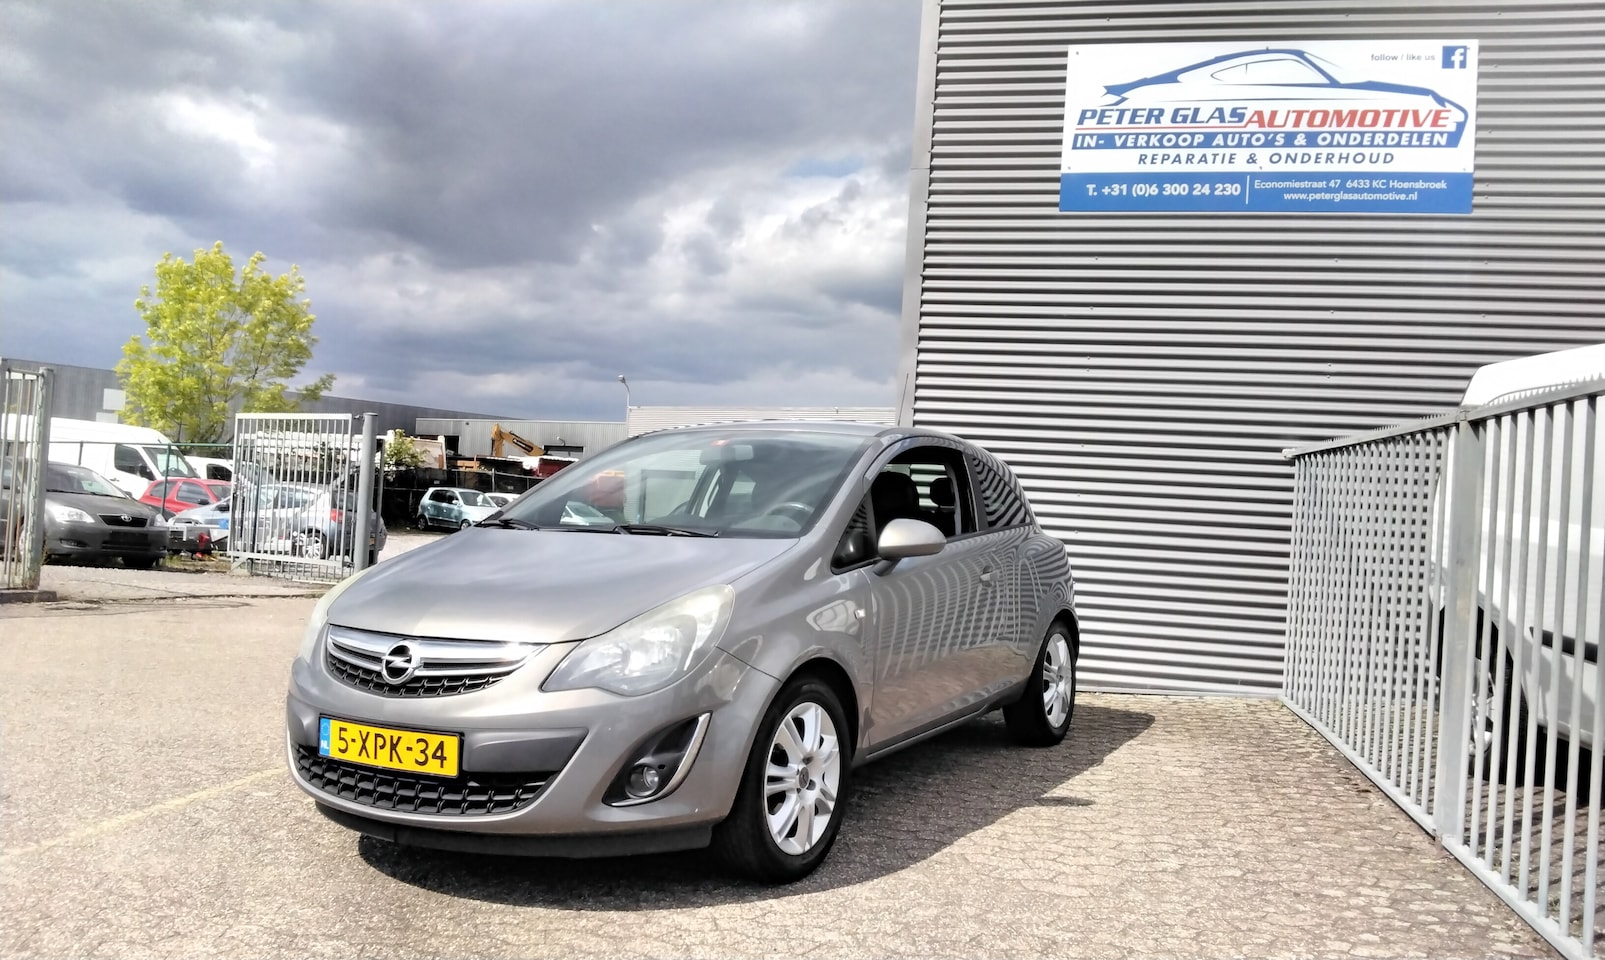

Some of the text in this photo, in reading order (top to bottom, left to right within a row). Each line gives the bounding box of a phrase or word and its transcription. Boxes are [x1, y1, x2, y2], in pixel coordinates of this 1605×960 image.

[1371, 53, 1398, 61] follow
[1406, 53, 1422, 61] like
[1077, 107, 1165, 126] PETER
[1076, 132, 1447, 148] IN- VERKOOP AUTO'S & ONDERDELEN
[1138, 152, 1394, 165] REPARATIE & ONDERHOUD
[1086, 183, 1241, 197] T. +31 (0)6 300 24 230
[1254, 180, 1447, 190] Economiestraat 47 6433 KC Hoensbroek
[1283, 191, 1418, 202] www.peterglasautomotive.nl
[320, 740, 329, 749] NL
[337, 726, 448, 769] 5-XPK-34
